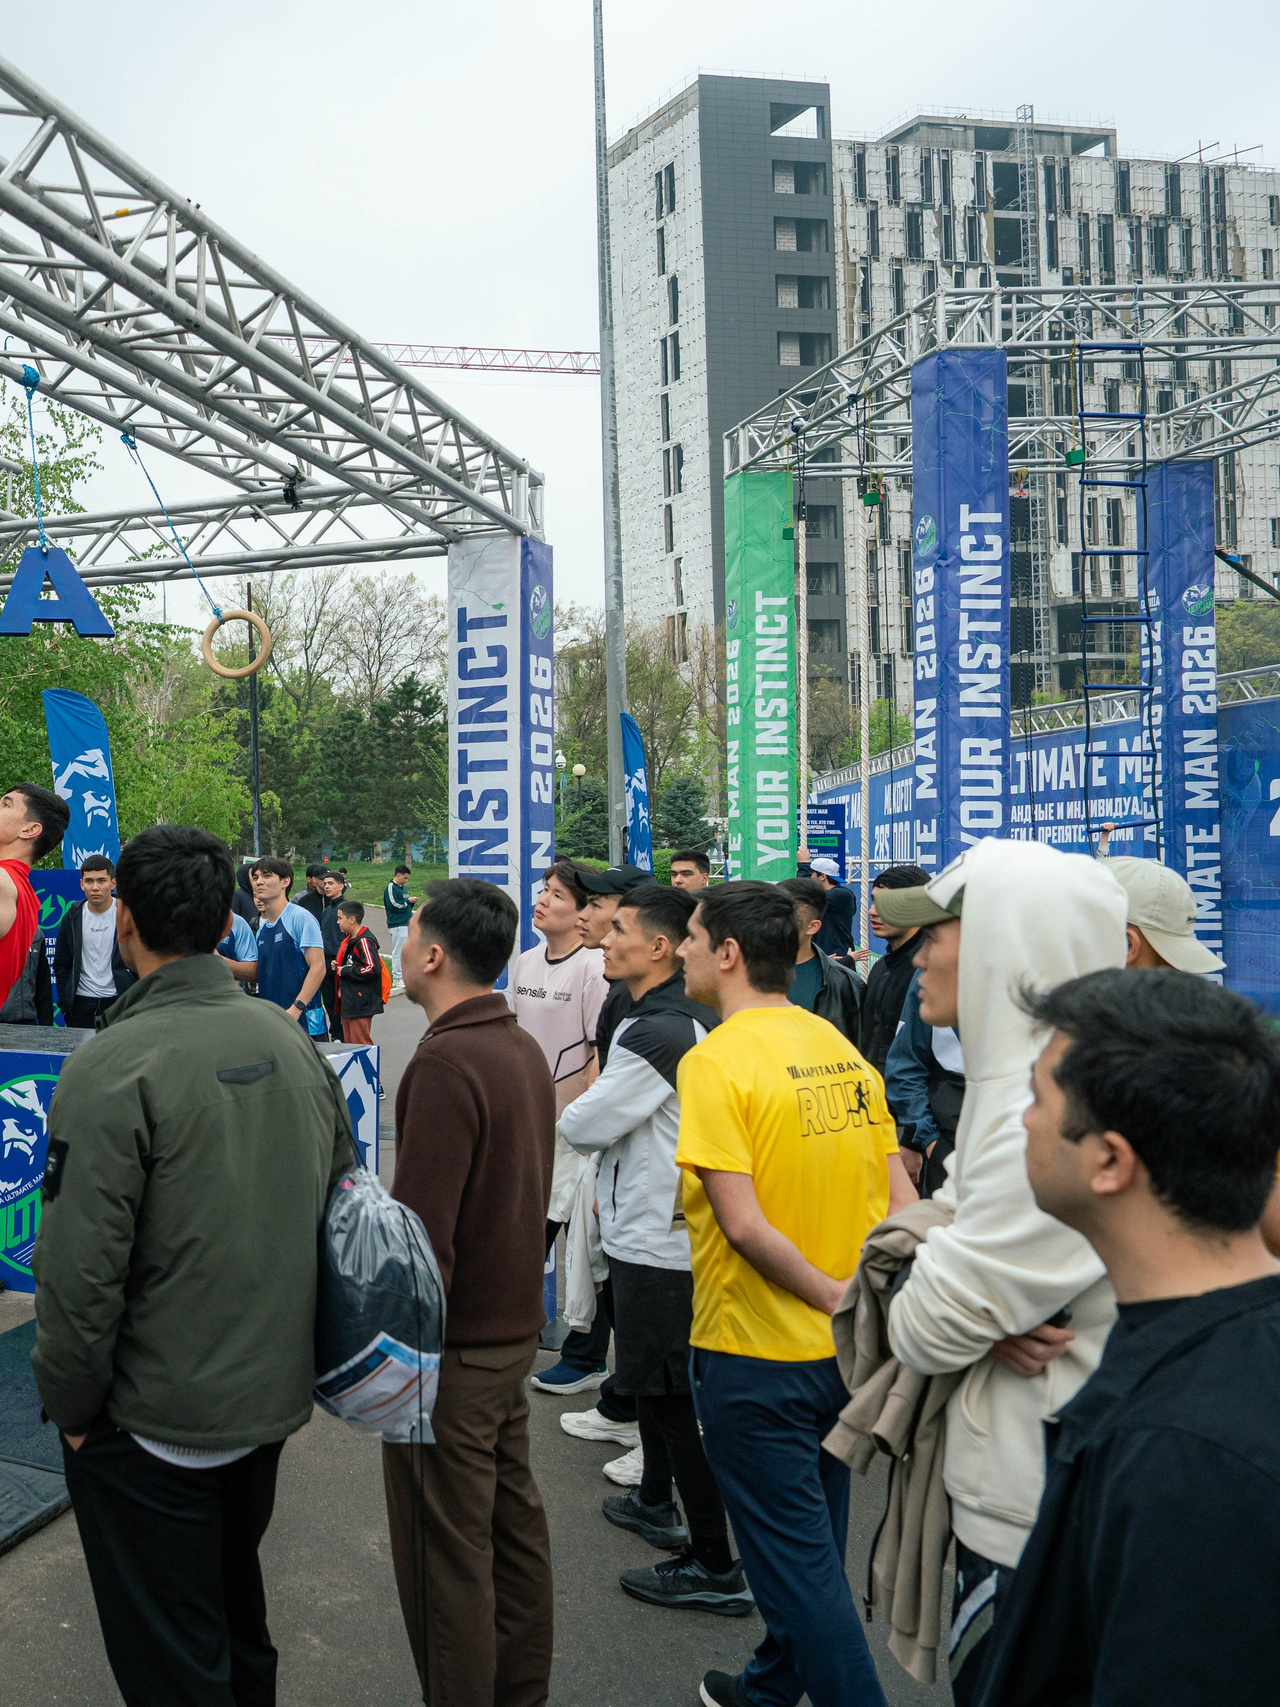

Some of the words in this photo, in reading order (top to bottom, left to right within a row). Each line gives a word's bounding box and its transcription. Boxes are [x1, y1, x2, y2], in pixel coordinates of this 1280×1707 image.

[914, 565, 937, 681] 2026
[958, 503, 1003, 718] INSTINCT
[726, 638, 741, 726] 2026
[755, 590, 789, 756] INSTINCT
[1181, 625, 1218, 715] 2026
[456, 606, 510, 886] INSTINCT
[529, 652, 554, 805] 2026
[915, 697, 938, 800] MAN
[1010, 740, 1108, 795] TIMATE
[1182, 729, 1220, 809] MAN
[726, 740, 741, 818] MAN
[756, 770, 791, 866] YOUR
[796, 1079, 877, 1138] RUN
[800, 1061, 865, 1078] KAPITALBAN
[3, 1181, 34, 1203] ULTIMATE
